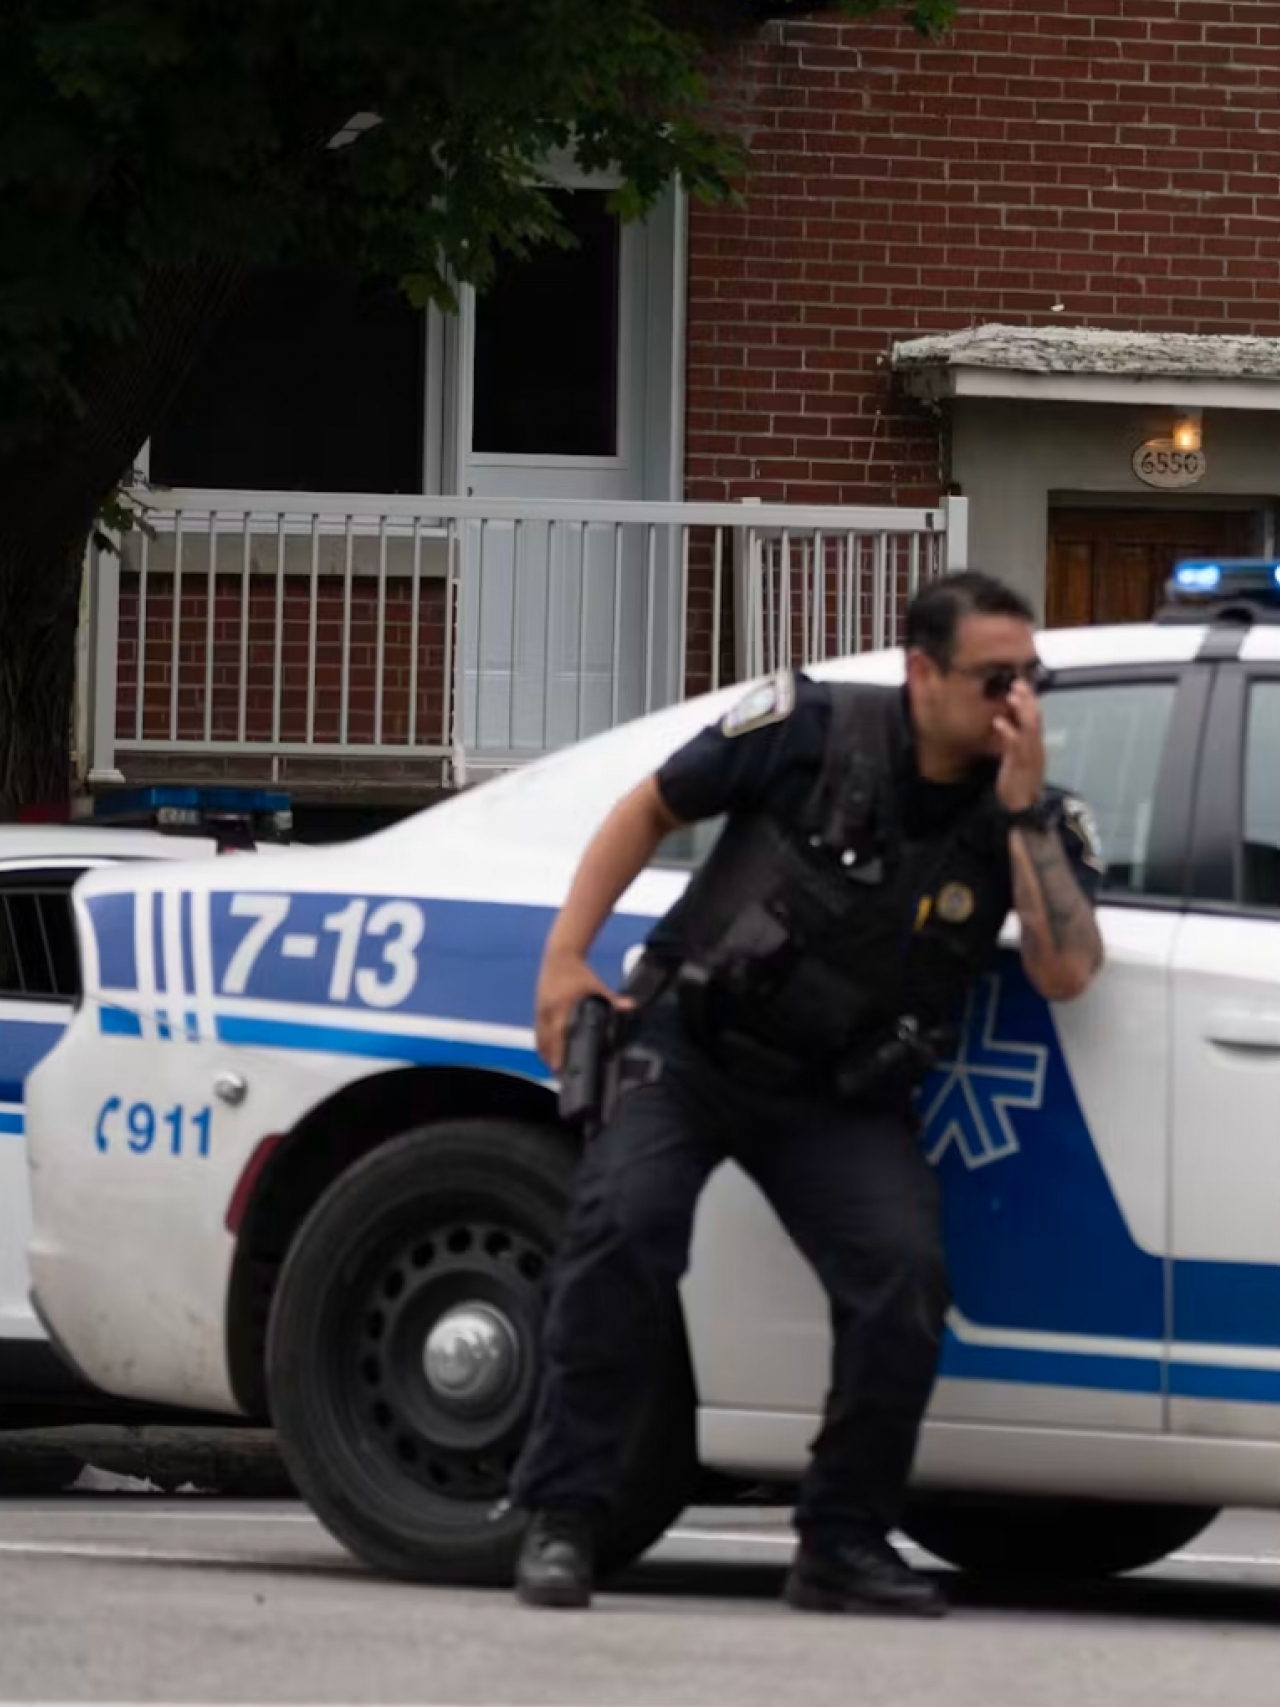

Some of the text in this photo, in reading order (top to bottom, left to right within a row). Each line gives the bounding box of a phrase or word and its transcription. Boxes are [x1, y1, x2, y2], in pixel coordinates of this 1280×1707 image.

[1141, 451, 1198, 474] 6550
[222, 893, 425, 1008] 7-13
[126, 1101, 212, 1156] 911
